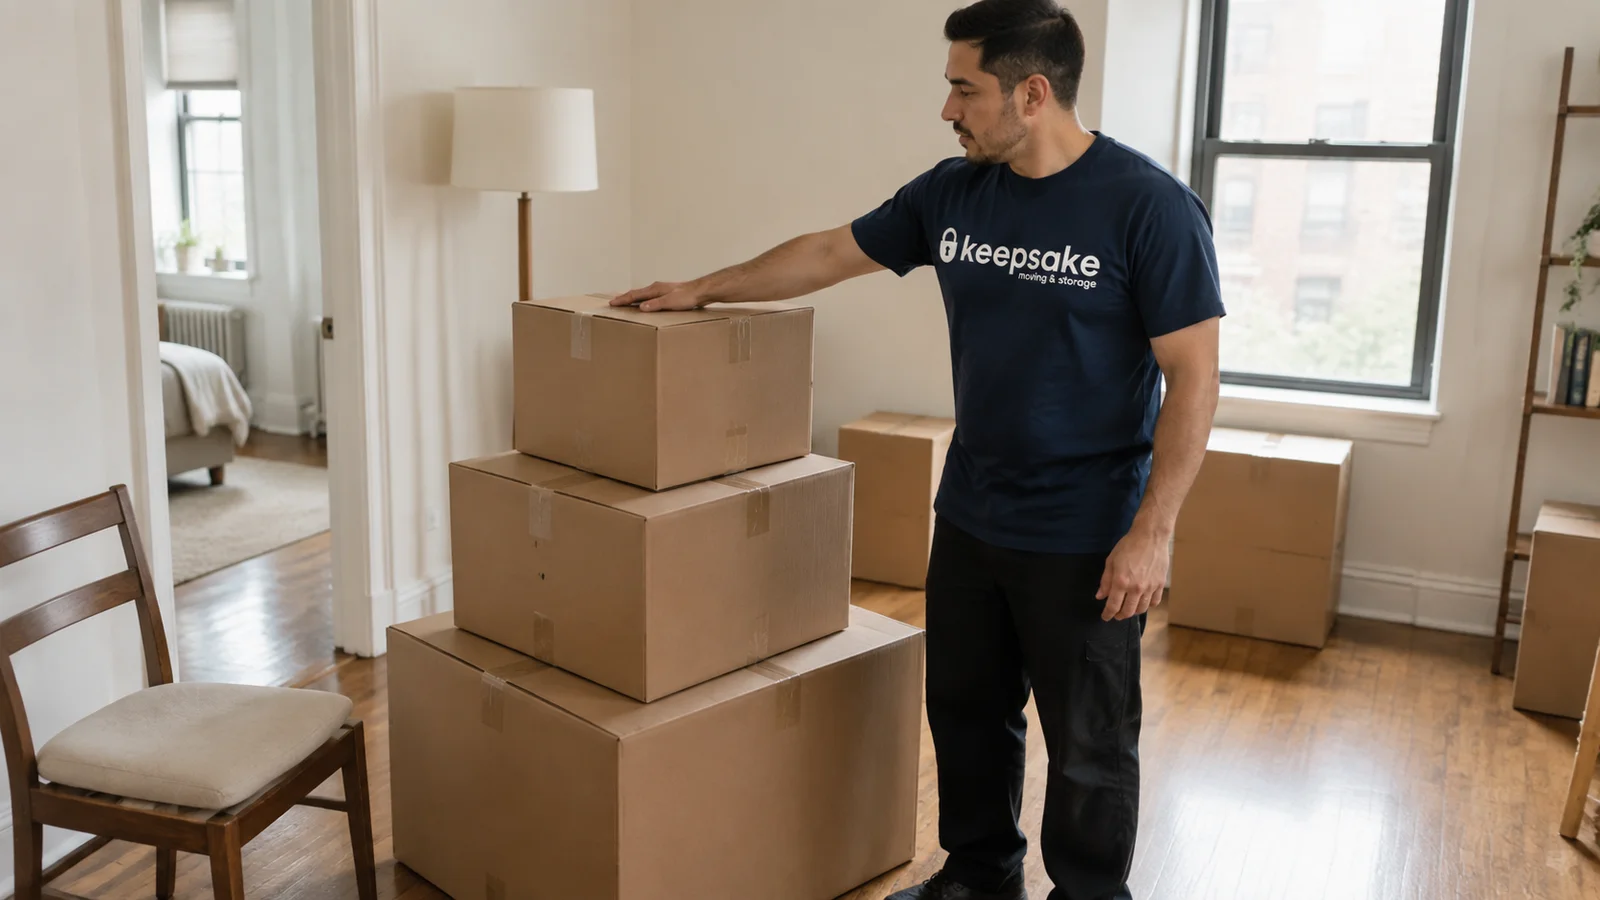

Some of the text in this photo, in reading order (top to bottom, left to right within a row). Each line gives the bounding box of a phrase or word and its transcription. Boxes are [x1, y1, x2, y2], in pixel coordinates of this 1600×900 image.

[960, 235, 1101, 277] keepsake
[1018, 272, 1097, 290] moving & storage
